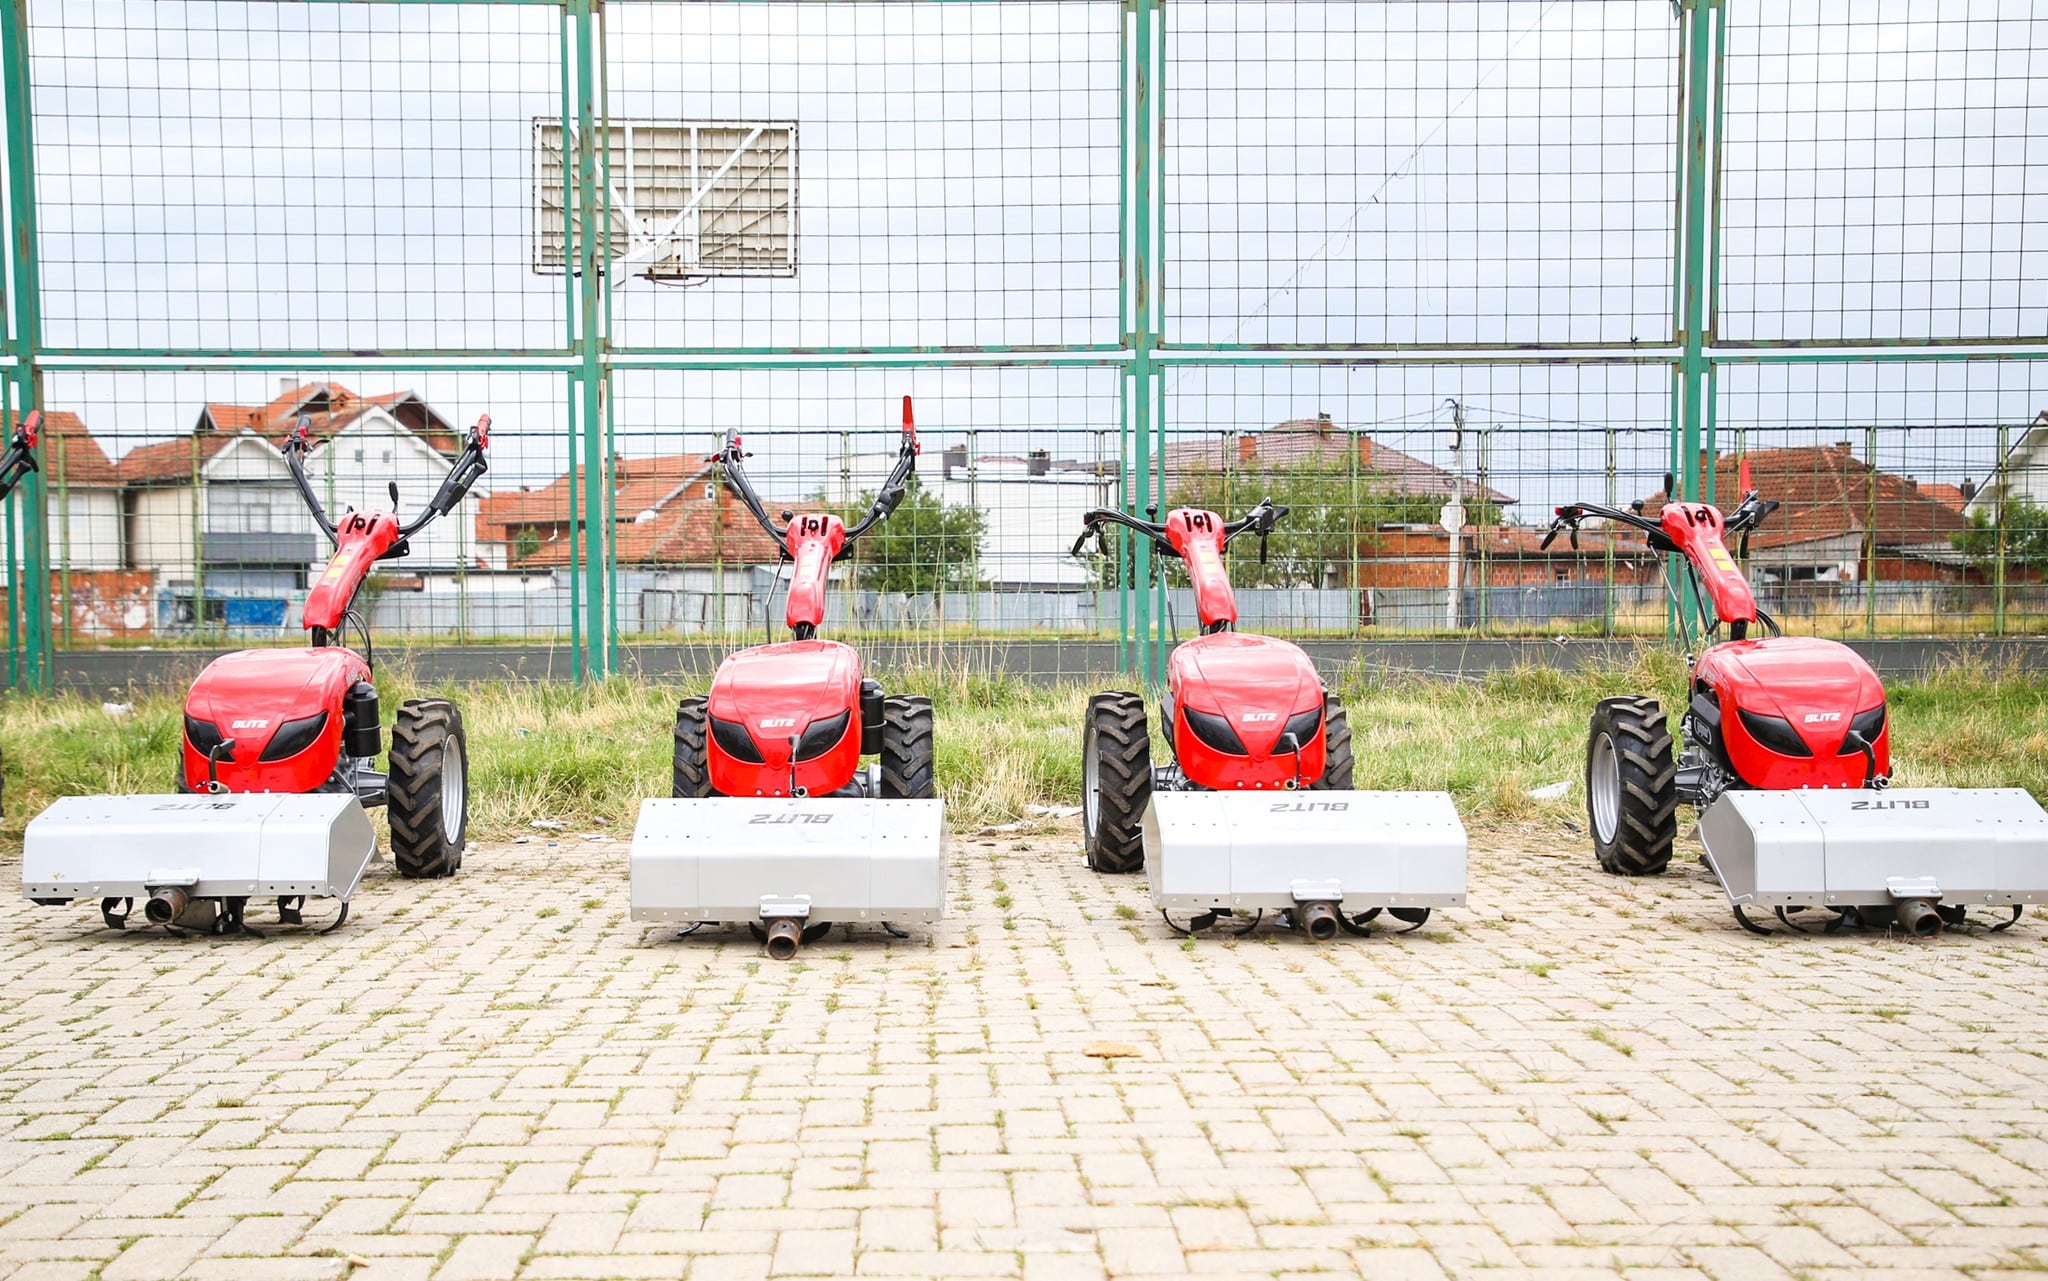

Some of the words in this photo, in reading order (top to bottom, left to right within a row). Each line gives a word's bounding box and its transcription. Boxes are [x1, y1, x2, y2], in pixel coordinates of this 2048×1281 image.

[1242, 712, 1277, 722] BLITZ
[1803, 712, 1841, 723] BLITZ
[231, 719, 269, 729] BLITZ
[760, 718, 797, 728] BLITZ
[1270, 802, 1350, 812] BLITZ
[1851, 800, 1930, 810] BLITZ
[748, 813, 834, 824] BLITZ
